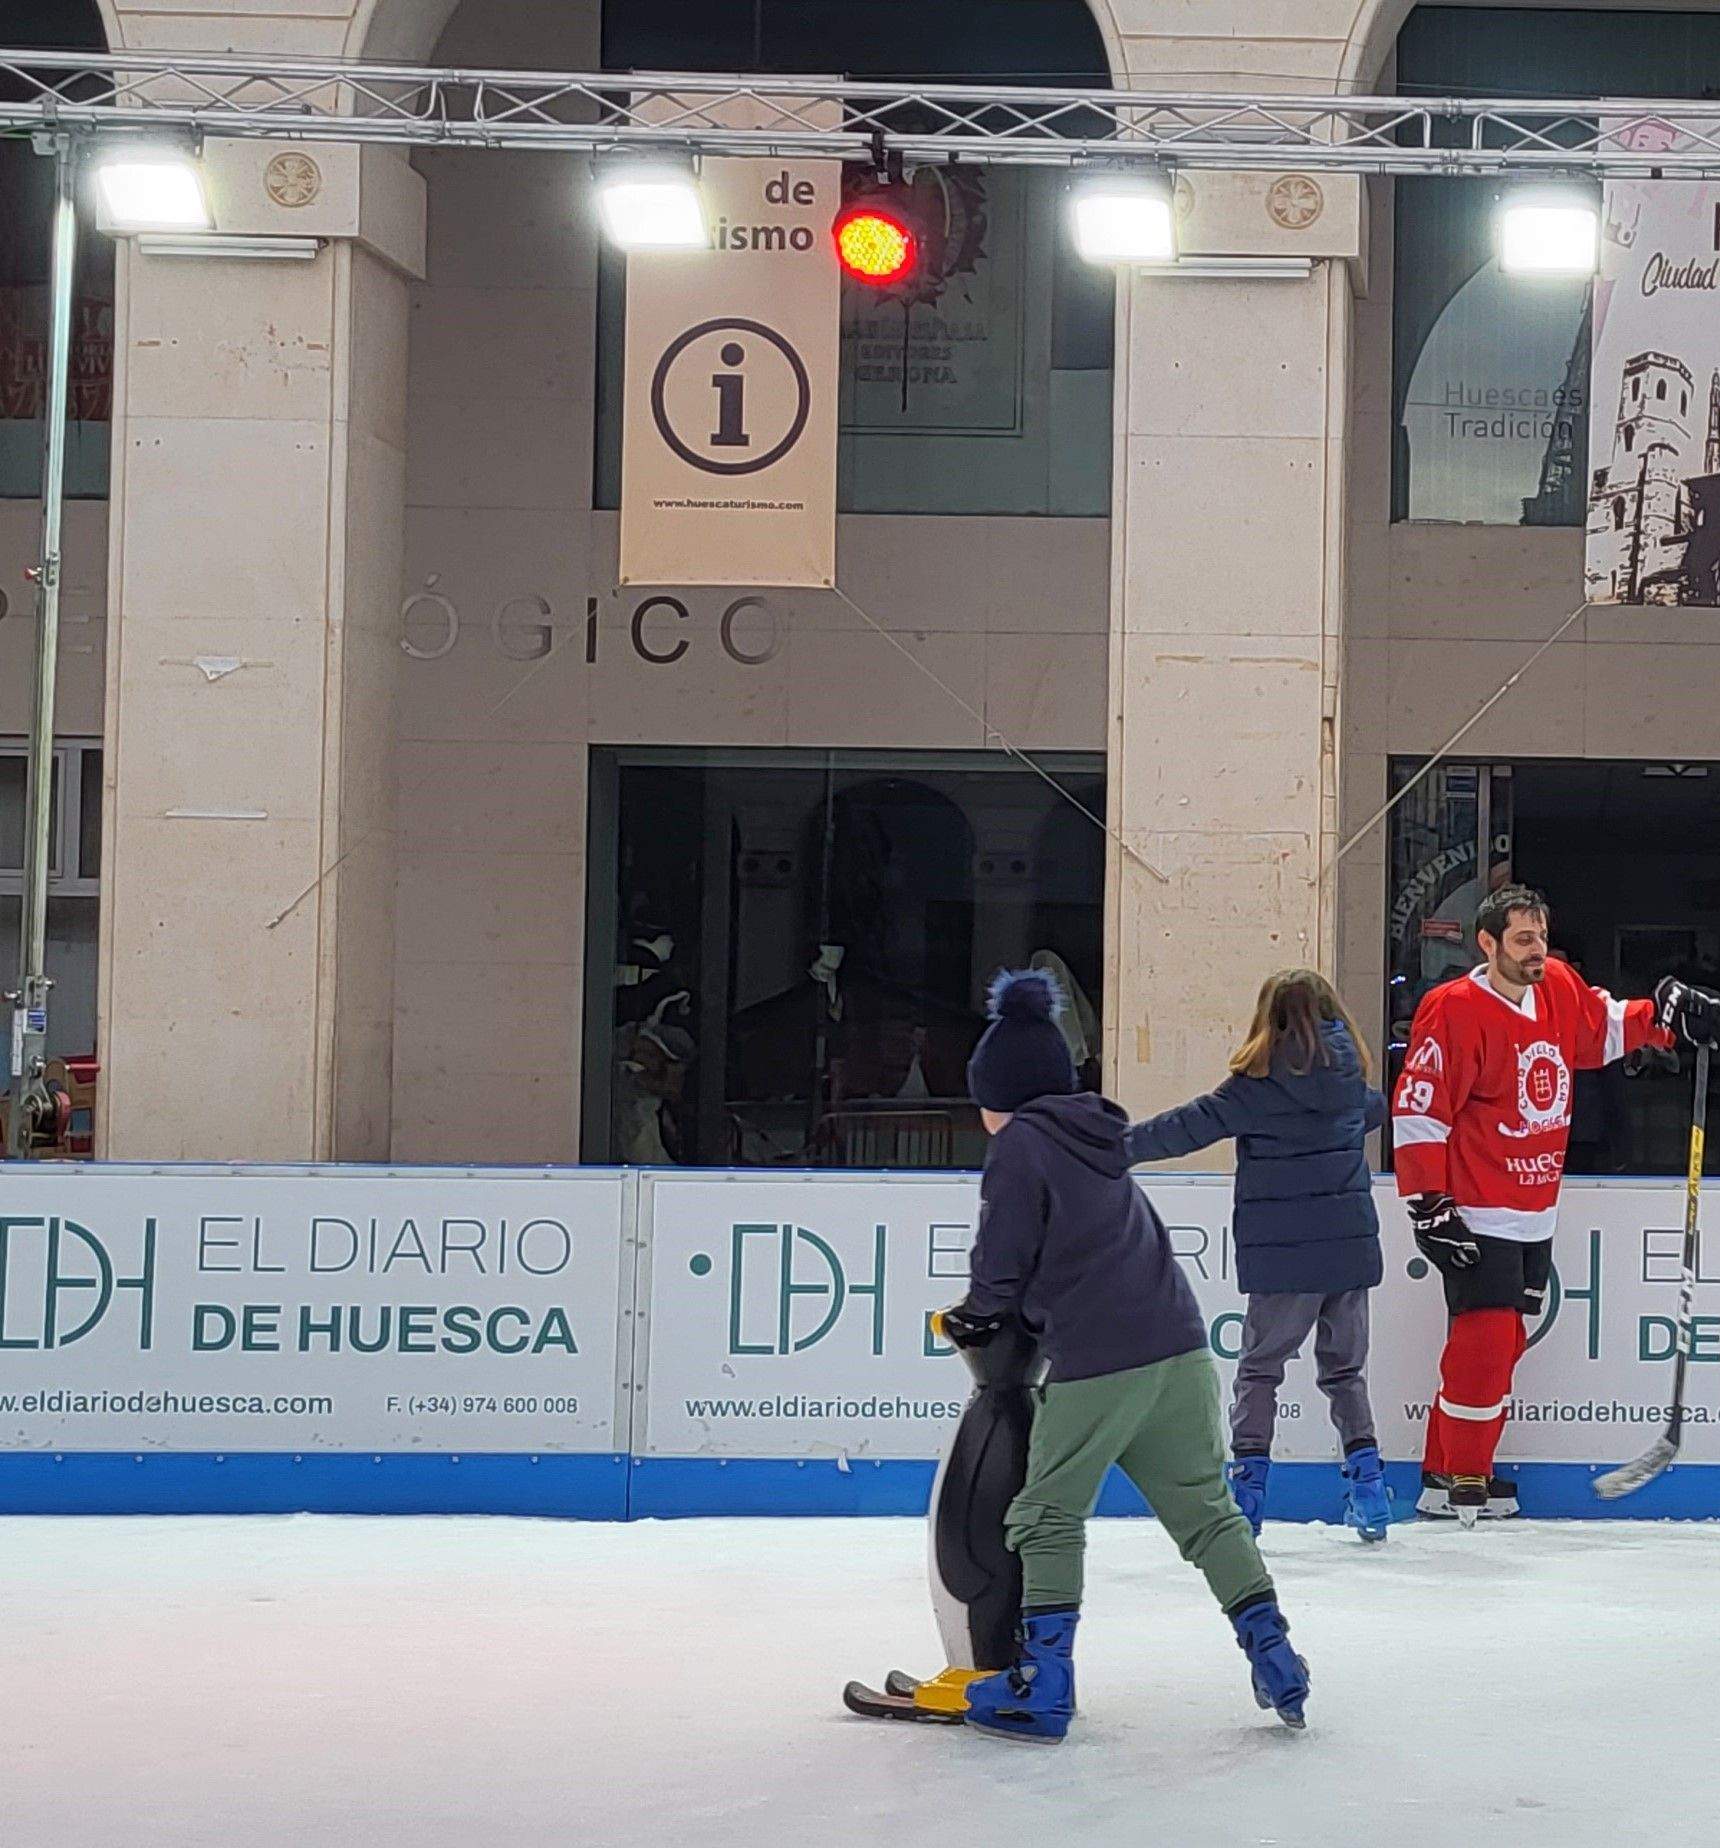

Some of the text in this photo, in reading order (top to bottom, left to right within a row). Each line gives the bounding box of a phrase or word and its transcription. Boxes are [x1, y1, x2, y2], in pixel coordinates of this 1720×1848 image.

[765, 170, 815, 205] de
[716, 215, 814, 250] ismo
[1641, 252, 1719, 297] Ciudad
[1444, 412, 1573, 439] Tradición
[653, 499, 804, 510] www.huescaturismo.com
[1391, 834, 1509, 940] BIENVENIO
[198, 1217, 572, 1275] EL DIARIO
[928, 1224, 972, 1278] E
[192, 1304, 579, 1355] DE HUESCA
[0, 1390, 333, 1414] w.eldiariodehuesca.com
[387, 1396, 578, 1416] F. (+34) 974 600 008
[685, 1393, 961, 1419] www.eldiariodehues
